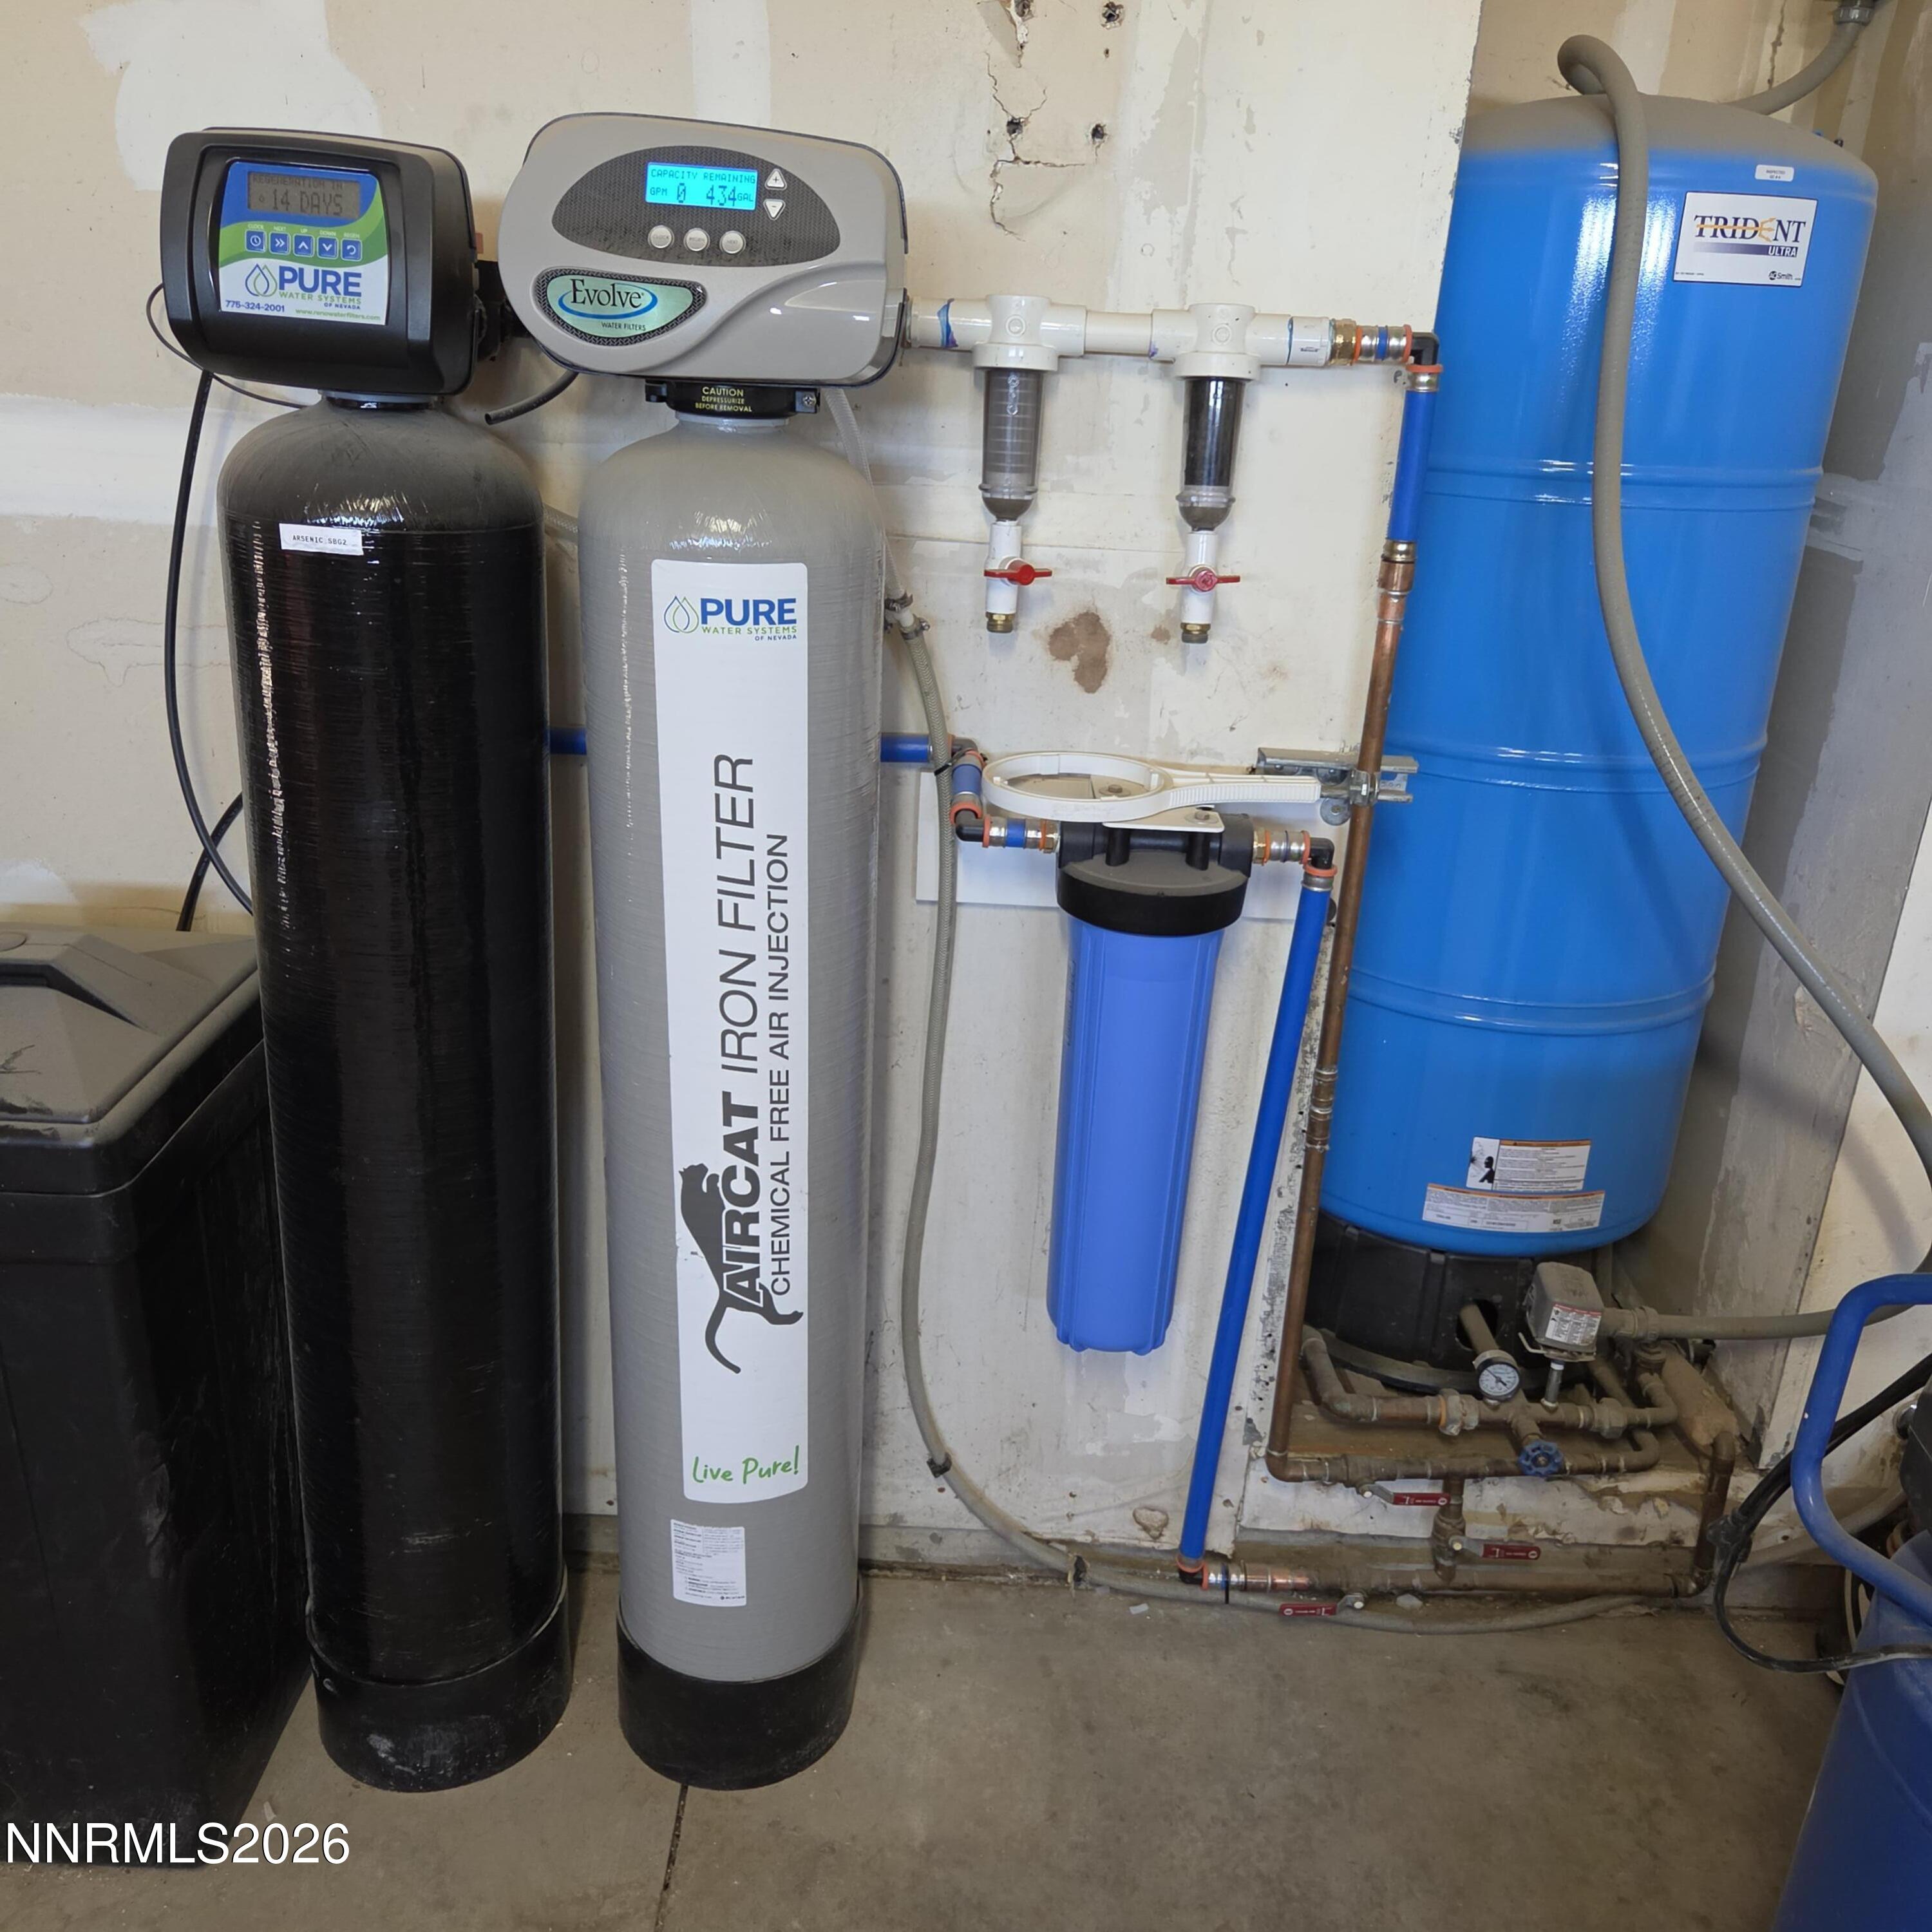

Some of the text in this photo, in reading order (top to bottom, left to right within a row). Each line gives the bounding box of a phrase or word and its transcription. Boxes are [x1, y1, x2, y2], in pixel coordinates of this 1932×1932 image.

[650, 169, 756, 184] CAPACITY REMAINING
[272, 188, 343, 216] 14 DAYS
[650, 183, 753, 207] GPM 0 434 GAL
[1694, 214, 1806, 243] TRIDENT
[1768, 245, 1798, 257] ULTRA
[279, 265, 362, 297] PURE
[279, 291, 362, 305] WATER SYSTEMS
[570, 278, 642, 308] Evolve
[225, 299, 285, 312] 775-324-2001
[601, 322, 621, 330] WATER
[702, 386, 744, 397] CAUTION
[701, 395, 744, 404] DEPRESSURIZE
[719, 404, 752, 412] REMOVAL
[292, 535, 323, 544] ARSENIC
[700, 598, 797, 626] PURE
[702, 625, 797, 635] WATER SYSTEMS
[714, 753, 762, 1305] AIRCAT IRON FILTER
[766, 833, 791, 1296] CHEMICAL FREE AIR INJECTION
[692, 1444, 799, 1484] Live Pure!
